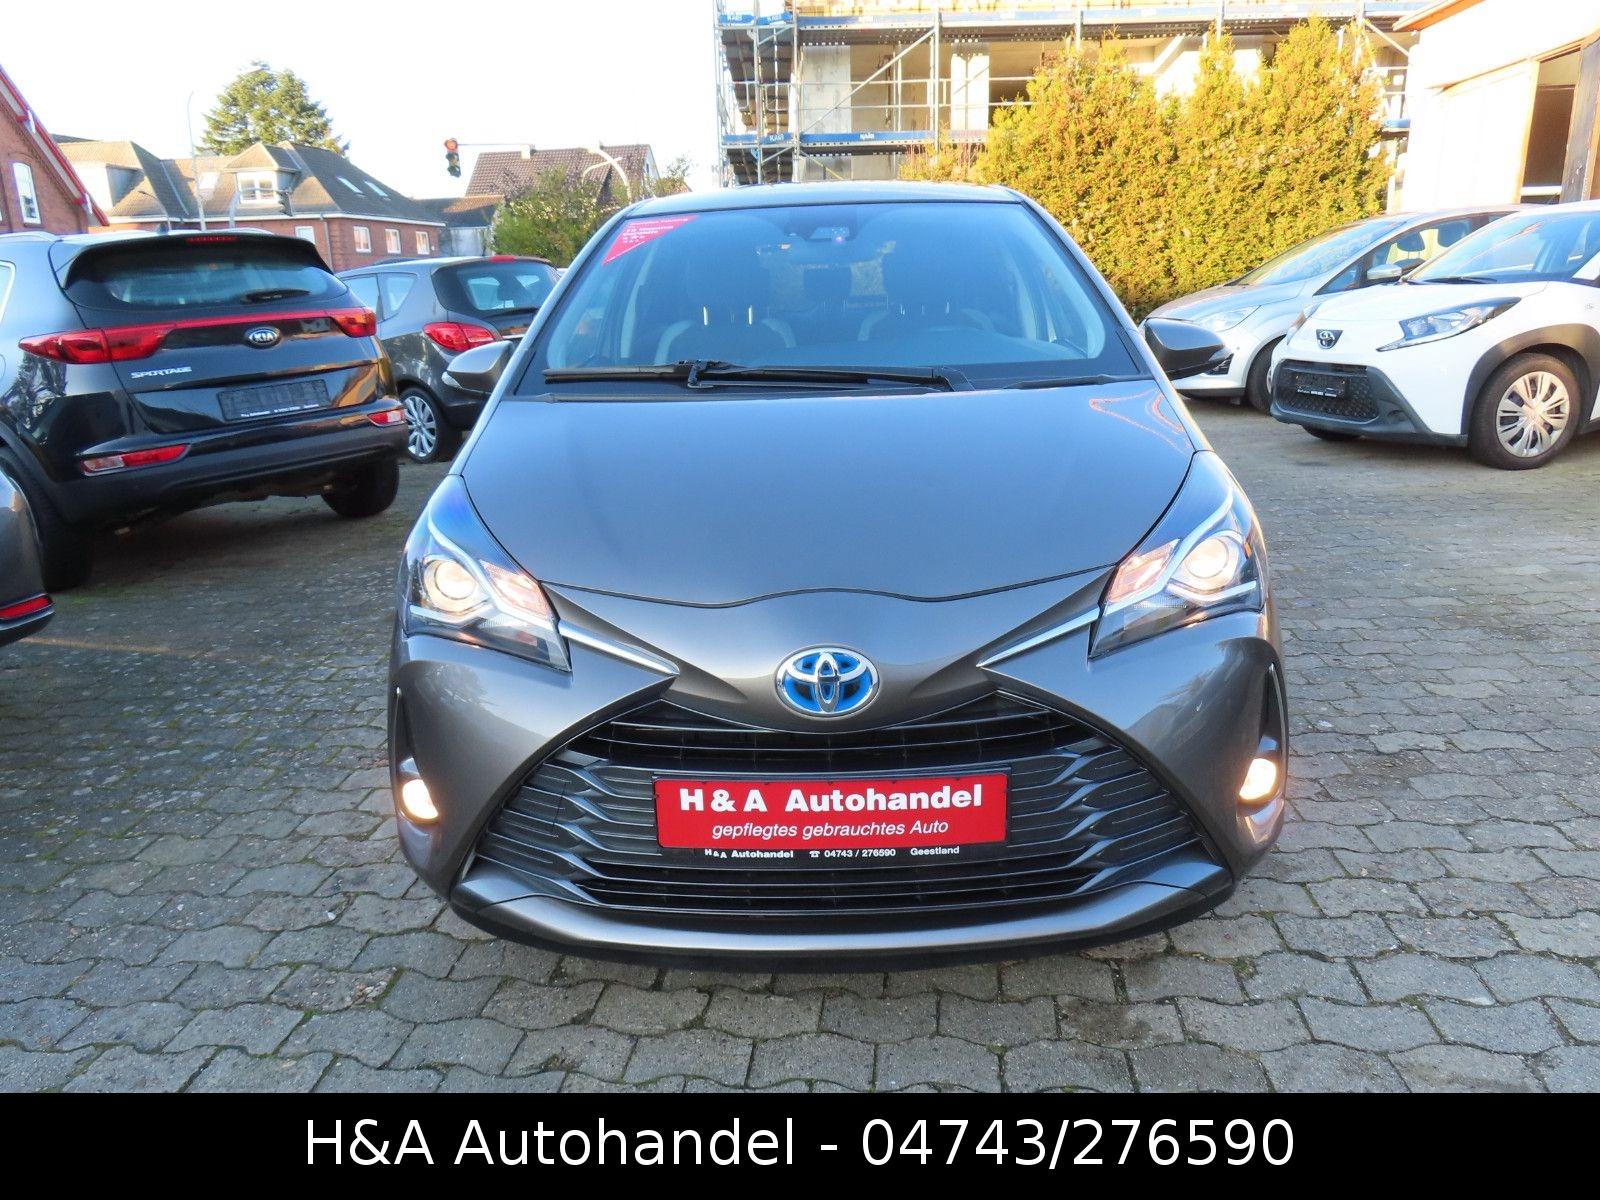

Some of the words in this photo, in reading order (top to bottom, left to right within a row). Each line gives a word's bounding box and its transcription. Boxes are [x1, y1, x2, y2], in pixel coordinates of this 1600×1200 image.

[254, 331, 272, 342] KIA
[131, 366, 192, 379] SPORTAGE
[785, 784, 982, 812] Autohandel
[712, 823, 798, 840] gepflegtes
[802, 820, 905, 839] gebrauchtes
[909, 819, 949, 834] Auto
[731, 850, 794, 859] Autohandel
[824, 849, 853, 858] 04743
[862, 848, 896, 858] 276590
[910, 846, 960, 857] Geestland
